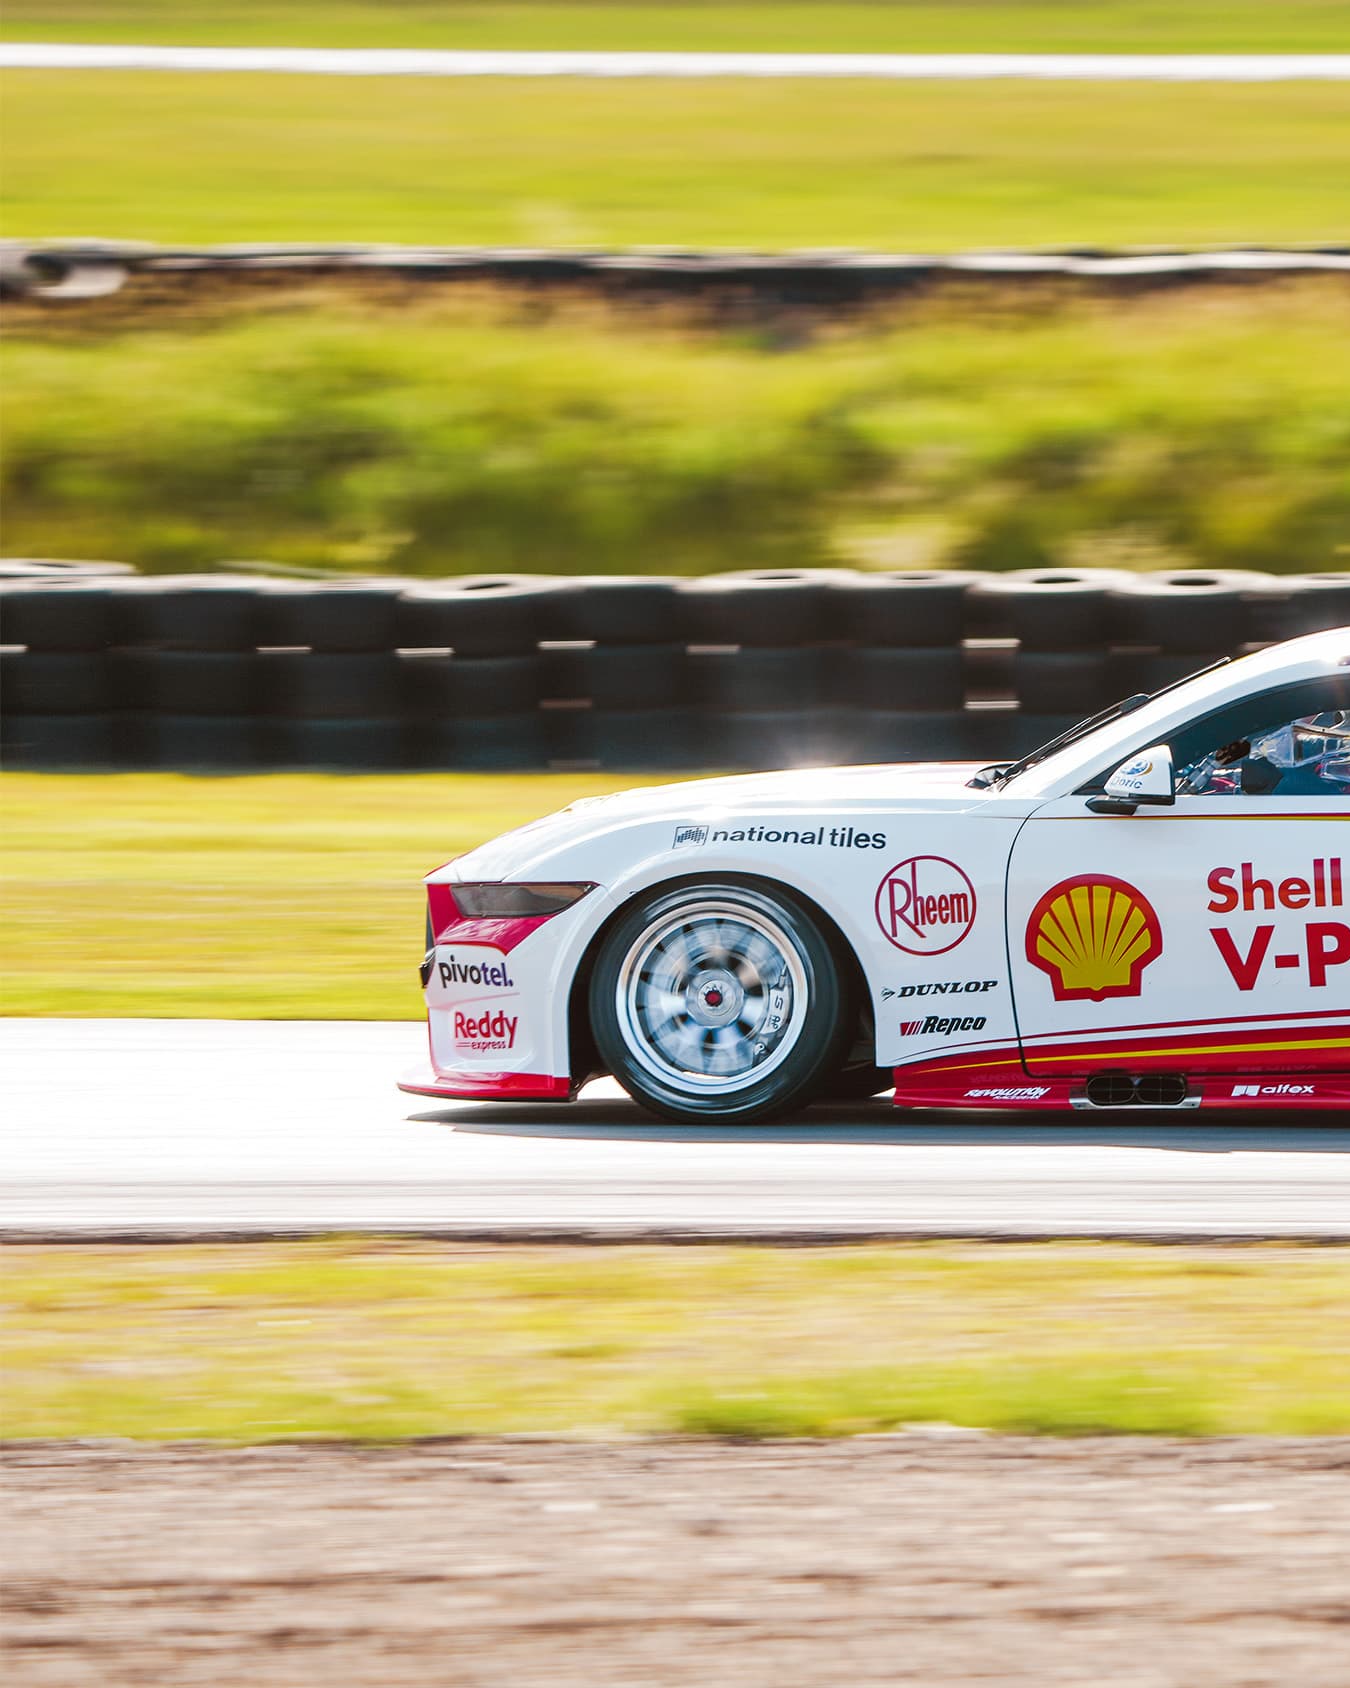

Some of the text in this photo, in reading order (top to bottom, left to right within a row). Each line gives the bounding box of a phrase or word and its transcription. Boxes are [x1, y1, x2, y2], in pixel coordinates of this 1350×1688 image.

[712, 826, 887, 849] national tiles
[1206, 857, 1343, 913] Shell
[888, 861, 969, 938] Rheem
[897, 980, 998, 998] DUNLOP
[454, 1010, 519, 1048] Reddy
[920, 1015, 987, 1036] Repco
[471, 1041, 506, 1053] express
[963, 1086, 1052, 1098] REVOLUTION
